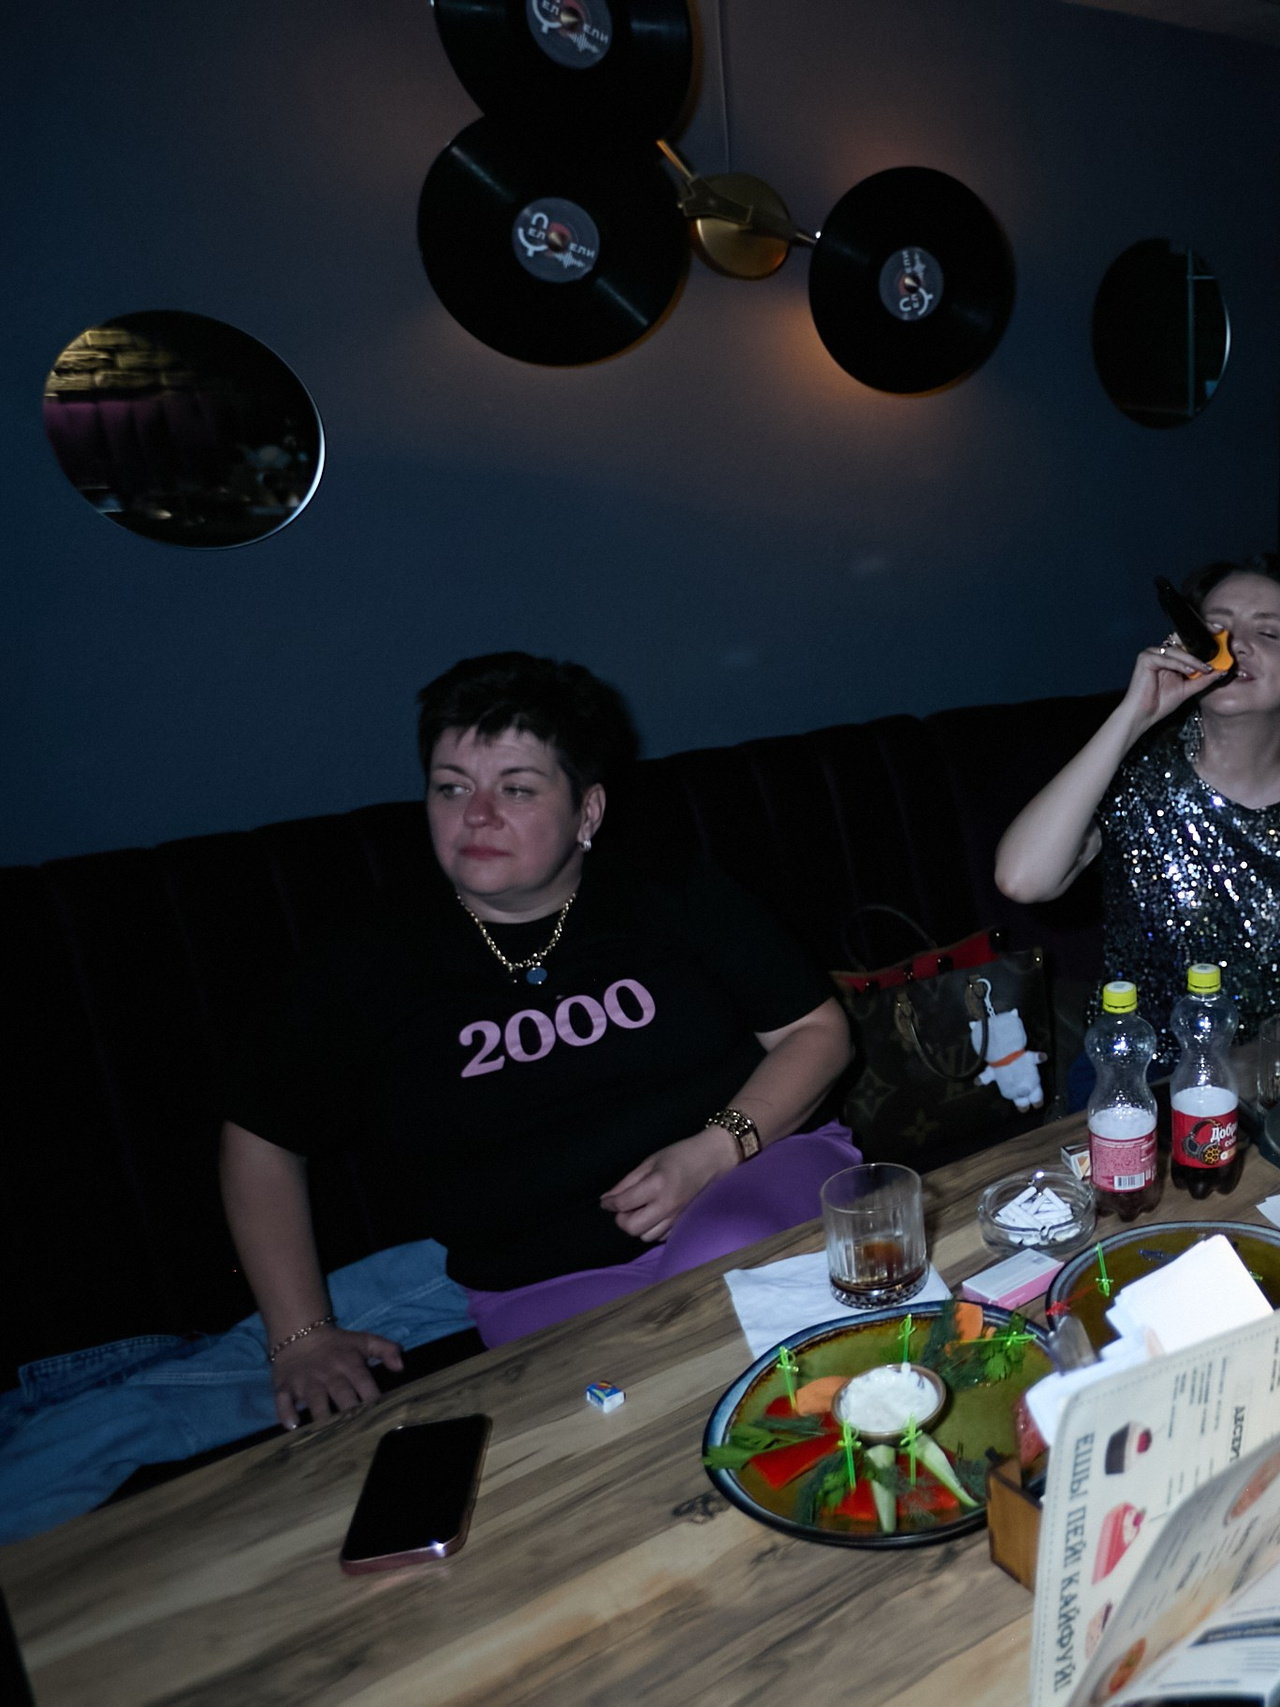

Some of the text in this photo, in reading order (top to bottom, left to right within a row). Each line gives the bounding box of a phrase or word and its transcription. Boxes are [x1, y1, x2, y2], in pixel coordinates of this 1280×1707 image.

[459, 978, 656, 1078] 2000
[1063, 1505, 1087, 1569] ПЕЙ!
[1053, 1569, 1081, 1694] КАЙФУЙ!
